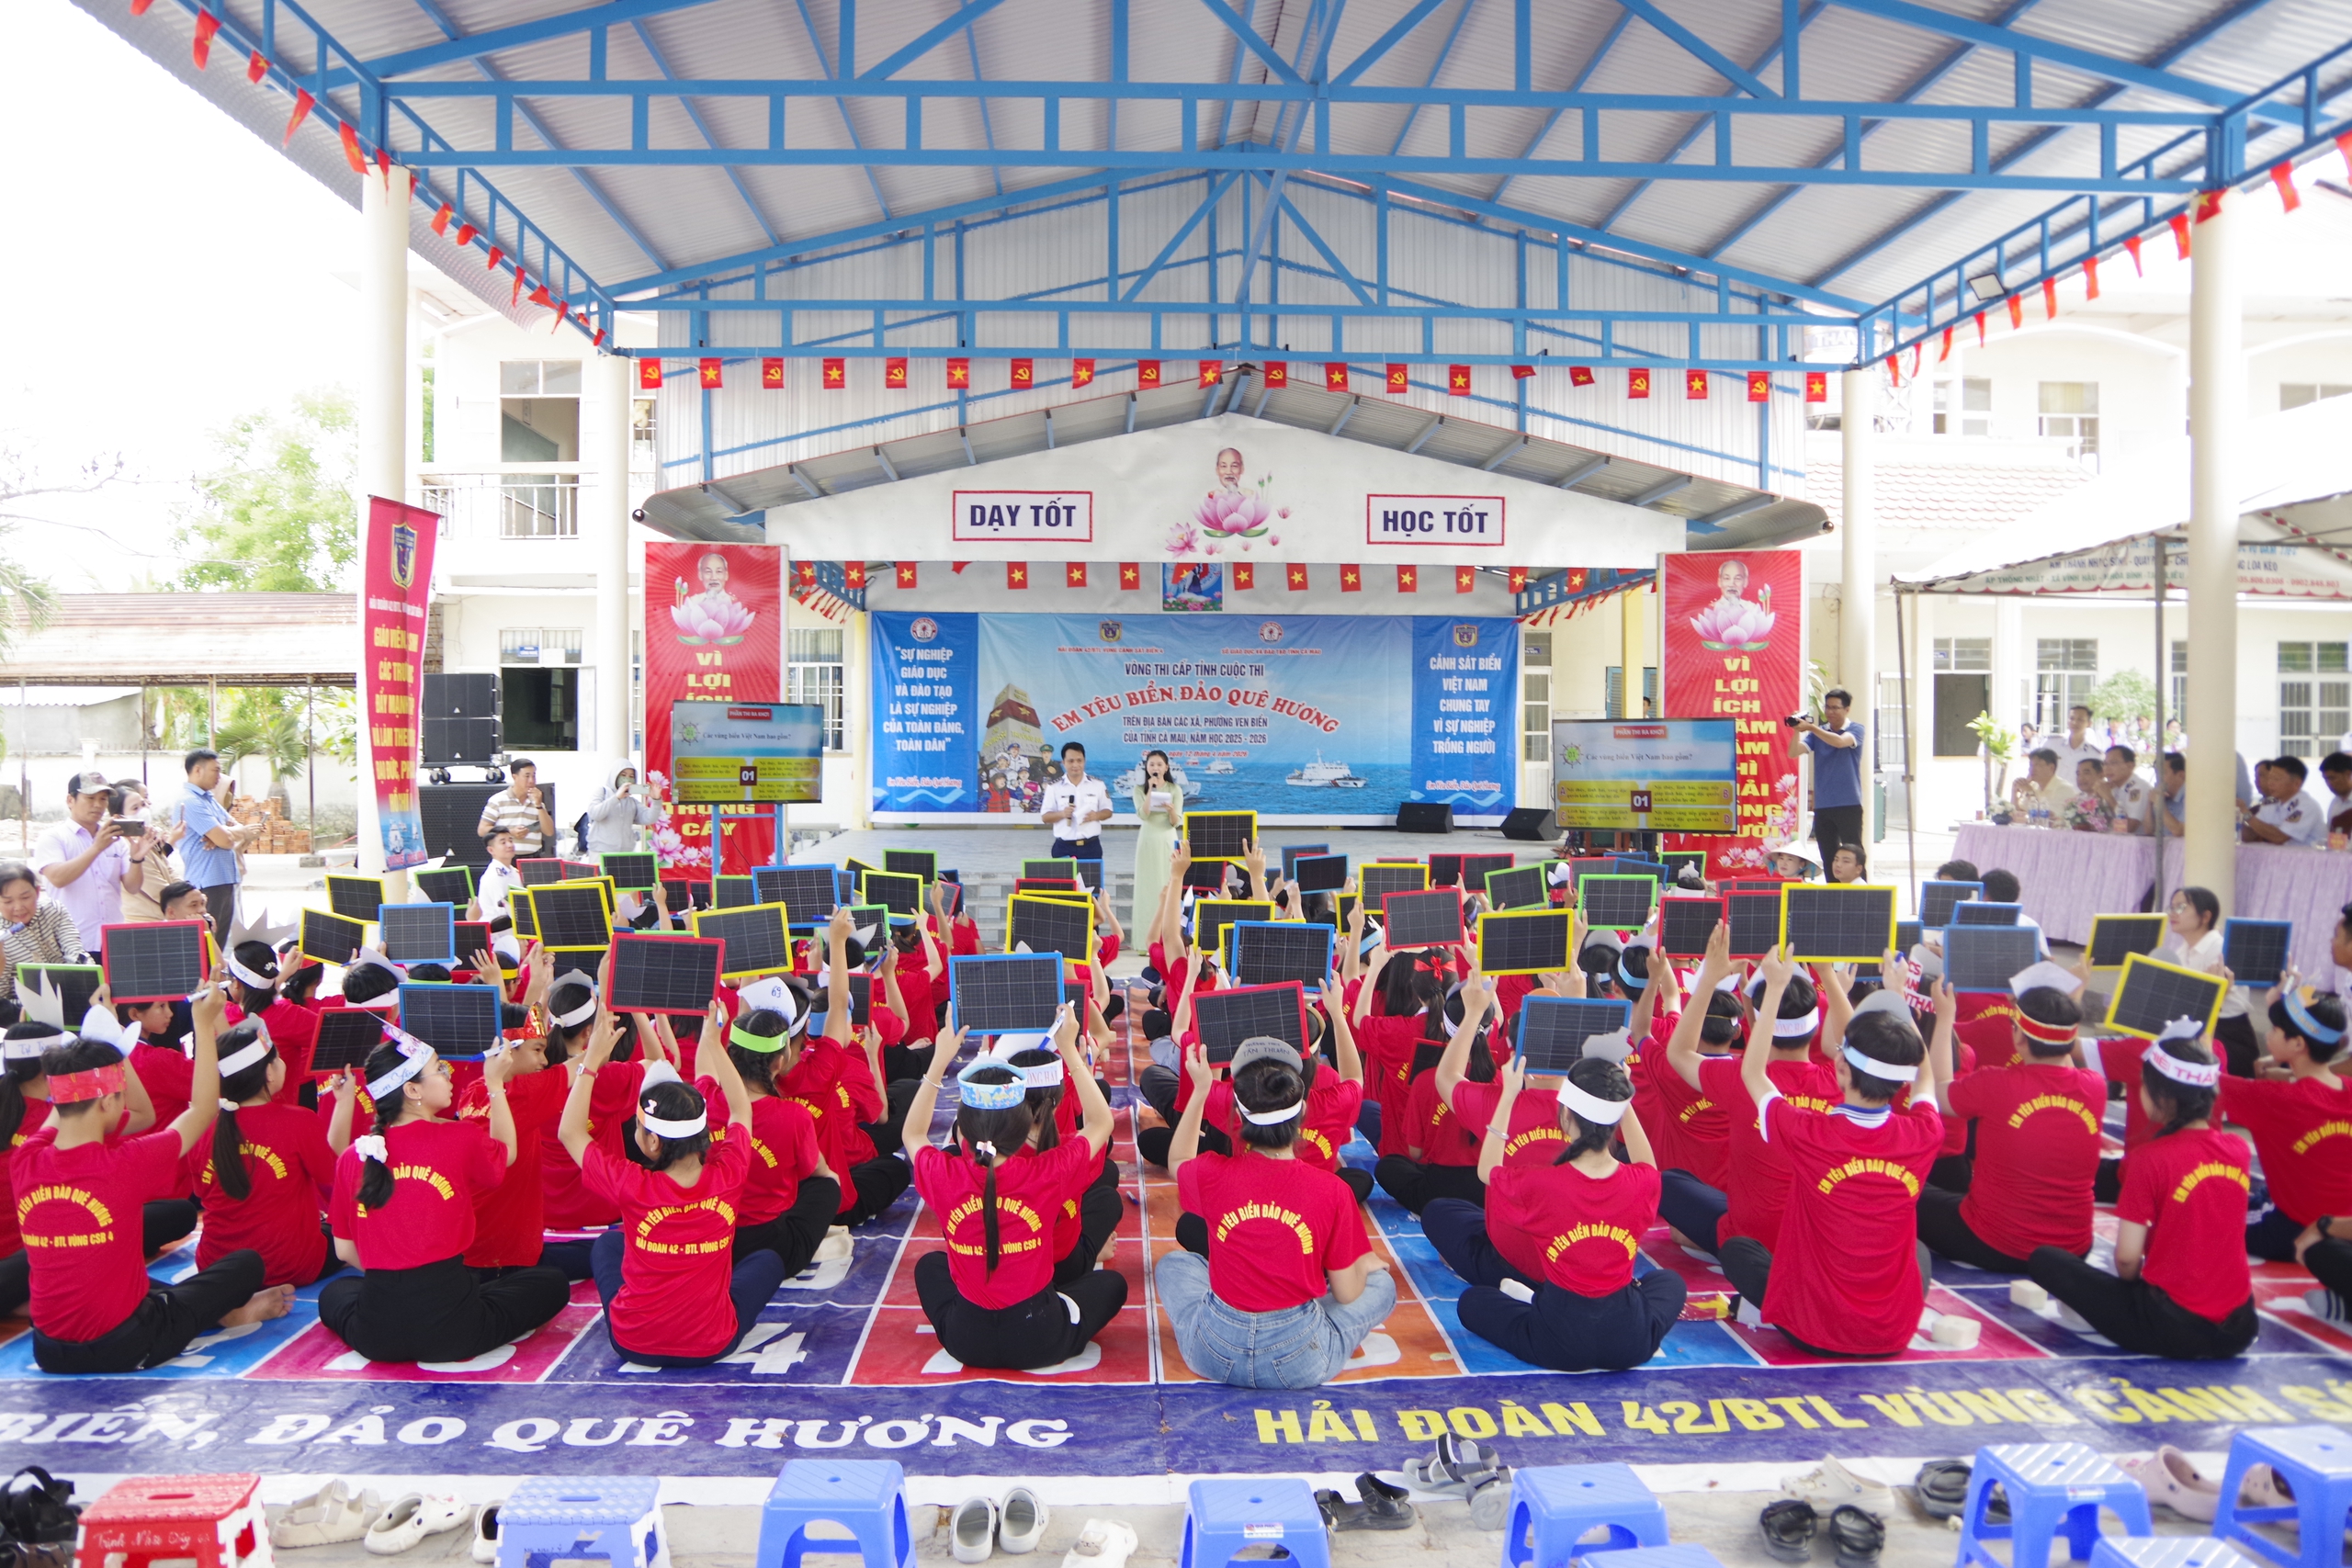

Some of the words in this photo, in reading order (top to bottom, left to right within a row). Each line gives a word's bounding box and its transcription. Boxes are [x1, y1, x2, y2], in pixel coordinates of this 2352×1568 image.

[970, 505, 1021, 531] DẠY
[1030, 497, 1076, 526] TỐT
[1383, 511, 1434, 536] HỌC
[1443, 503, 1488, 533] TỐT
[695, 650, 722, 666] VÌ
[917, 648, 953, 663] NGHIỆP
[1430, 653, 1456, 671] CẢNH
[1458, 656, 1476, 671] SÁT
[1478, 653, 1501, 671] BIỂN
[1724, 656, 1750, 671] VÌ
[900, 665, 924, 679] GIÁO
[927, 667, 947, 681] DỤC
[1125, 661, 1151, 675] VÒNG
[1155, 664, 1170, 675] THI
[1172, 659, 1192, 676] CẤP
[1195, 660, 1216, 676] TỈNH
[1220, 662, 1246, 679] CUỘC
[1250, 665, 1264, 676] THI
[686, 671, 731, 690] LỢI
[1442, 676, 1463, 694] VIỆT
[1464, 678, 1487, 692] NAM
[1714, 677, 1758, 694] LỢI
[895, 683, 909, 696] VÀ
[910, 683, 931, 696] ĐÀO
[933, 685, 952, 699] TẠO
[889, 702, 902, 715] LÀ
[904, 704, 919, 717] SỰ
[921, 704, 957, 717] NGHIỆP
[1051, 710, 1082, 731] EM
[1081, 695, 1122, 717] YÊU
[1125, 680, 1178, 706] BIỂN,
[1180, 680, 1222, 701] ĐẢO
[1227, 689, 1269, 707] QUÊ
[1271, 697, 1340, 732] HƯƠNG
[1439, 699, 1472, 712] CHUNG
[1474, 699, 1490, 712] TAY
[1713, 696, 1761, 713] ÍCH
[883, 718, 904, 733] CỦA
[905, 720, 932, 733] TOÀN
[933, 719, 964, 735] ĐẢNG,
[1123, 715, 1140, 727] TRÊN
[1143, 716, 1155, 728] ĐỊA
[1157, 715, 1171, 727] BÀN
[1174, 715, 1188, 727] CÁC
[1190, 716, 1203, 728] XÃ,
[1204, 716, 1233, 728] PHƯỜNG
[1235, 717, 1250, 728] VEN
[1251, 714, 1268, 728] BIỂN
[1433, 718, 1442, 733] VÌ
[1445, 719, 1460, 735] SỰ
[1461, 718, 1496, 736] NGHIỆP
[896, 738, 922, 751] TOÀN
[1124, 731, 1138, 743] CỦA
[1140, 730, 1156, 743] TỈNH
[1158, 731, 1169, 743] CÀ
[1170, 734, 1188, 744] MAU,
[1191, 732, 1207, 743] NĂM
[1209, 734, 1223, 746] HỌC
[1226, 734, 1242, 743] 2025
[1250, 734, 1267, 744] 2026
[1432, 737, 1464, 753] TRỒNG
[1466, 739, 1496, 754] NGƯỜI
[741, 771, 756, 781] 01
[1633, 795, 1649, 807] 01
[1505, 1145, 1518, 1156] EM
[1514, 1134, 1530, 1148] YÊU
[1529, 1125, 1546, 1141] BIỂN
[392, 1162, 411, 1179] ĐẢO
[961, 1194, 984, 1215] BIỂN
[1003, 1198, 1023, 1214] QUÊ
[1238, 1199, 1261, 1221] BIỂN
[1261, 1201, 1281, 1220] ĐẢO
[1221, 1211, 1239, 1230] YÊU
[1281, 1209, 1301, 1228] QUÊ
[1216, 1224, 1228, 1243] EM
[1553, 1235, 1570, 1252] YÊU
[1567, 1222, 1590, 1243] BIỂN
[1591, 1220, 1610, 1237] ĐẢO
[669, 1245, 679, 1255] 42
[685, 1244, 698, 1255] BTL
[700, 1241, 718, 1254] VÙNG
[974, 1246, 983, 1256] 42
[1003, 1242, 1023, 1254] VÙNG
[1023, 1238, 1036, 1251] CSB
[1253, 1400, 1379, 1444] HẢI
[1396, 1399, 1607, 1441] ĐOÀN
[1621, 1393, 1870, 1437] 42/BTL
[1859, 1385, 2082, 1427] VÙNG
[245, 1404, 468, 1446] ĐẢO
[482, 1410, 695, 1452] QUÊ
[713, 1413, 1075, 1450] HƯƠNG
